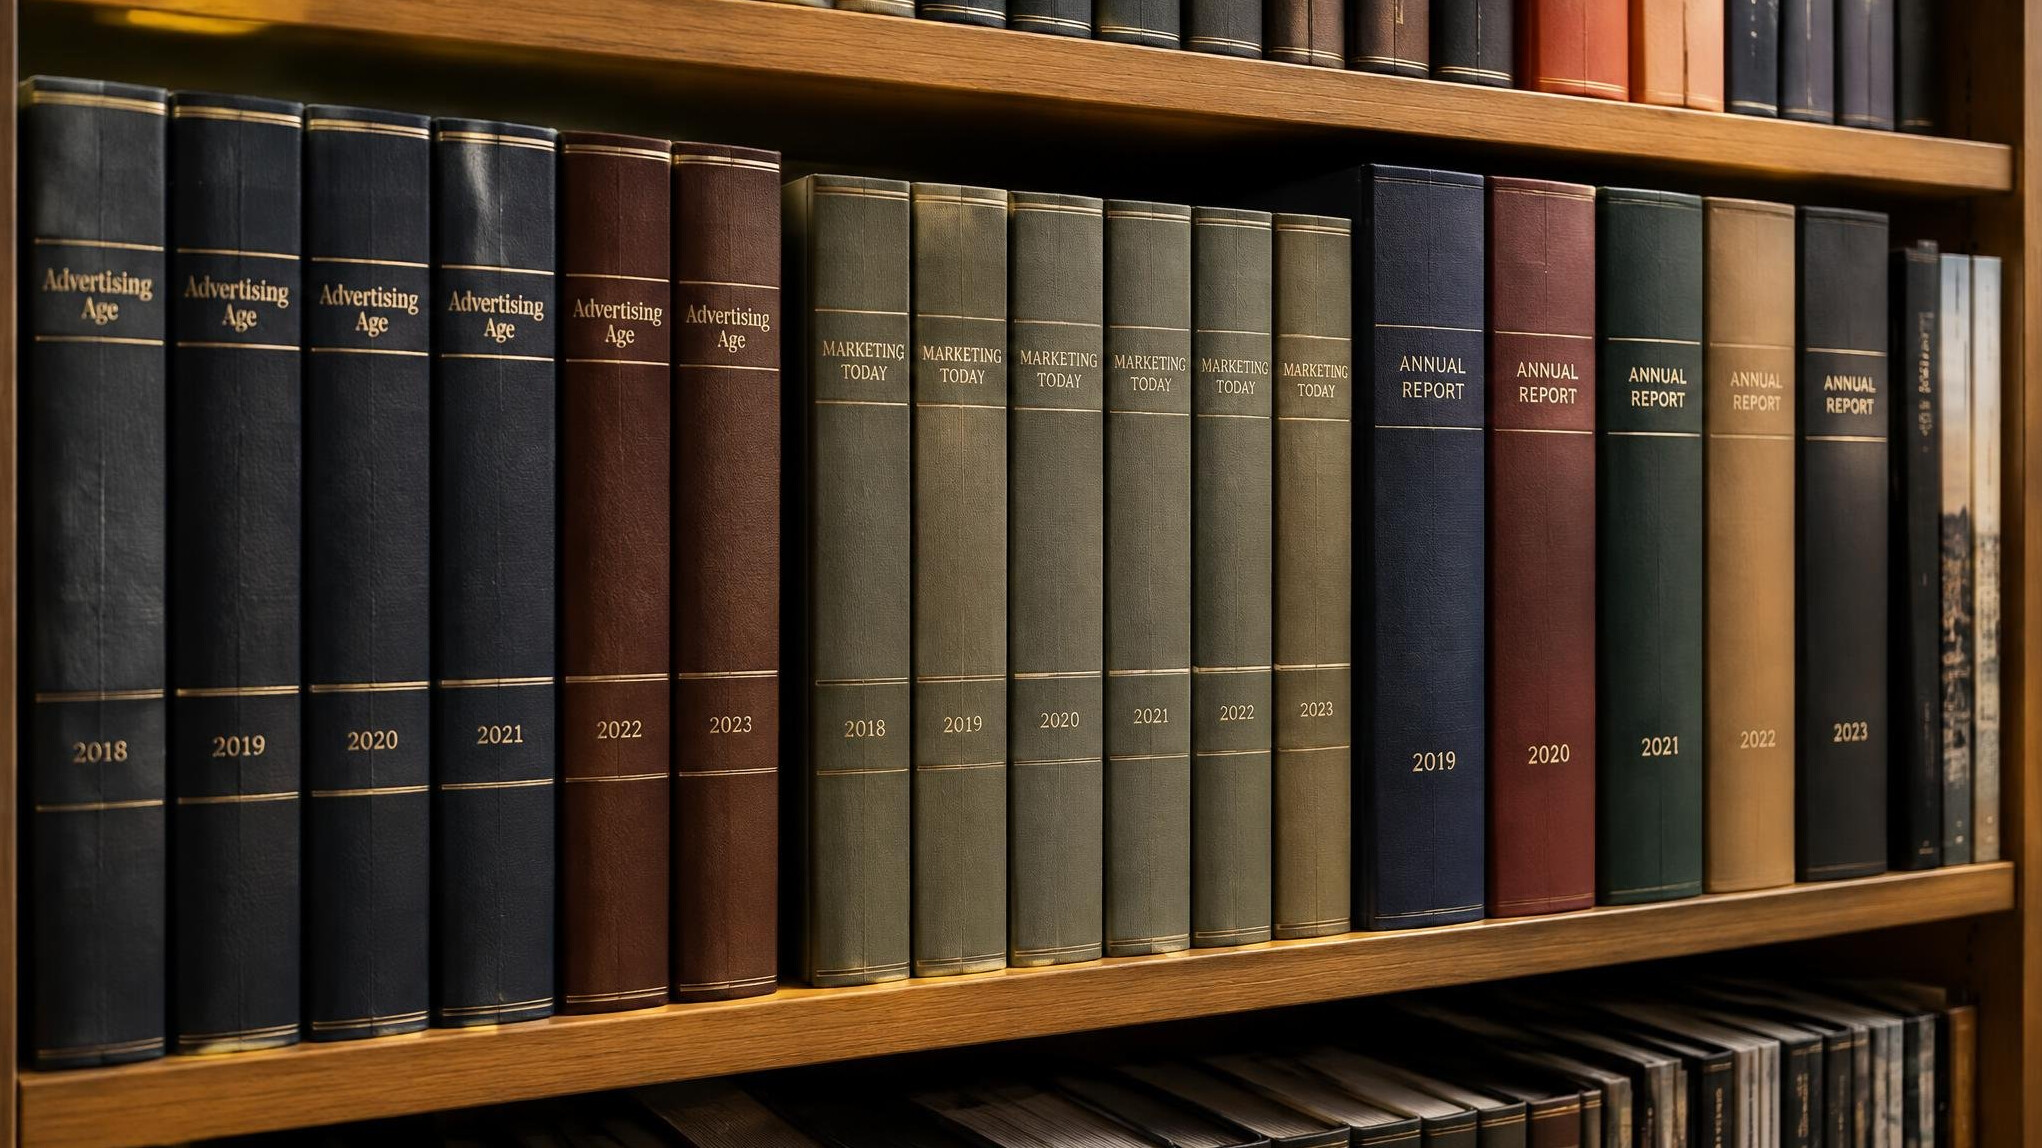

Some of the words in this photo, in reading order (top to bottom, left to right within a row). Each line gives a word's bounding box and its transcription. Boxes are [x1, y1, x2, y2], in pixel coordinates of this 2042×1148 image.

[42, 267, 153, 301] Advertising
[184, 275, 289, 309] Advertising
[319, 283, 419, 315] Advertising
[448, 290, 545, 321] Advertising
[82, 296, 119, 325] Age
[222, 303, 257, 331] Age
[573, 297, 663, 327] Advertising
[686, 305, 771, 333] Advertising
[355, 310, 389, 338] Age
[484, 316, 515, 344] Age
[605, 324, 635, 349] Age
[717, 329, 746, 354] Age
[822, 340, 905, 361] MARKETING
[922, 344, 1002, 363] MARKETING
[1020, 349, 1098, 368] MARKETING
[840, 363, 888, 381] TODAY
[1114, 354, 1186, 372] MARKETING
[1201, 358, 1269, 376] MARKETING
[1283, 362, 1349, 379] MARKETING
[1399, 355, 1467, 375] ANNUAL
[1516, 361, 1579, 380] ANNUAL
[939, 367, 985, 385] TODAY
[1036, 372, 1082, 389] TODAY
[1130, 376, 1172, 392] TODAY
[1628, 367, 1688, 385] ANNUAL
[1730, 371, 1783, 389] ANNUAL
[1824, 375, 1877, 394] ANNUAL
[1216, 379, 1256, 395] TODAY
[1297, 383, 1336, 398] TODAY
[1402, 381, 1465, 400] REPORT
[1519, 386, 1578, 404] REPORT
[1631, 390, 1686, 408] REPORT
[1733, 394, 1782, 412] REPORT
[1826, 397, 1875, 415] REPORT
[1133, 707, 1169, 724] 2021
[1220, 704, 1255, 721] 2022
[1300, 700, 1334, 718] 2023
[597, 720, 642, 739] 2022
[709, 715, 752, 734] 2023
[844, 719, 886, 738] 2018
[943, 715, 983, 733] 2019
[1040, 711, 1080, 729] 2020
[348, 729, 399, 751] 2020
[477, 724, 524, 744] 2021
[1740, 728, 1777, 749] 2022
[1833, 721, 1868, 743] 2023
[75, 740, 128, 763] 2018
[212, 734, 266, 757] 2019
[1528, 743, 1570, 765] 2020
[1641, 735, 1679, 757] 2021
[1412, 750, 1456, 772] 2019
